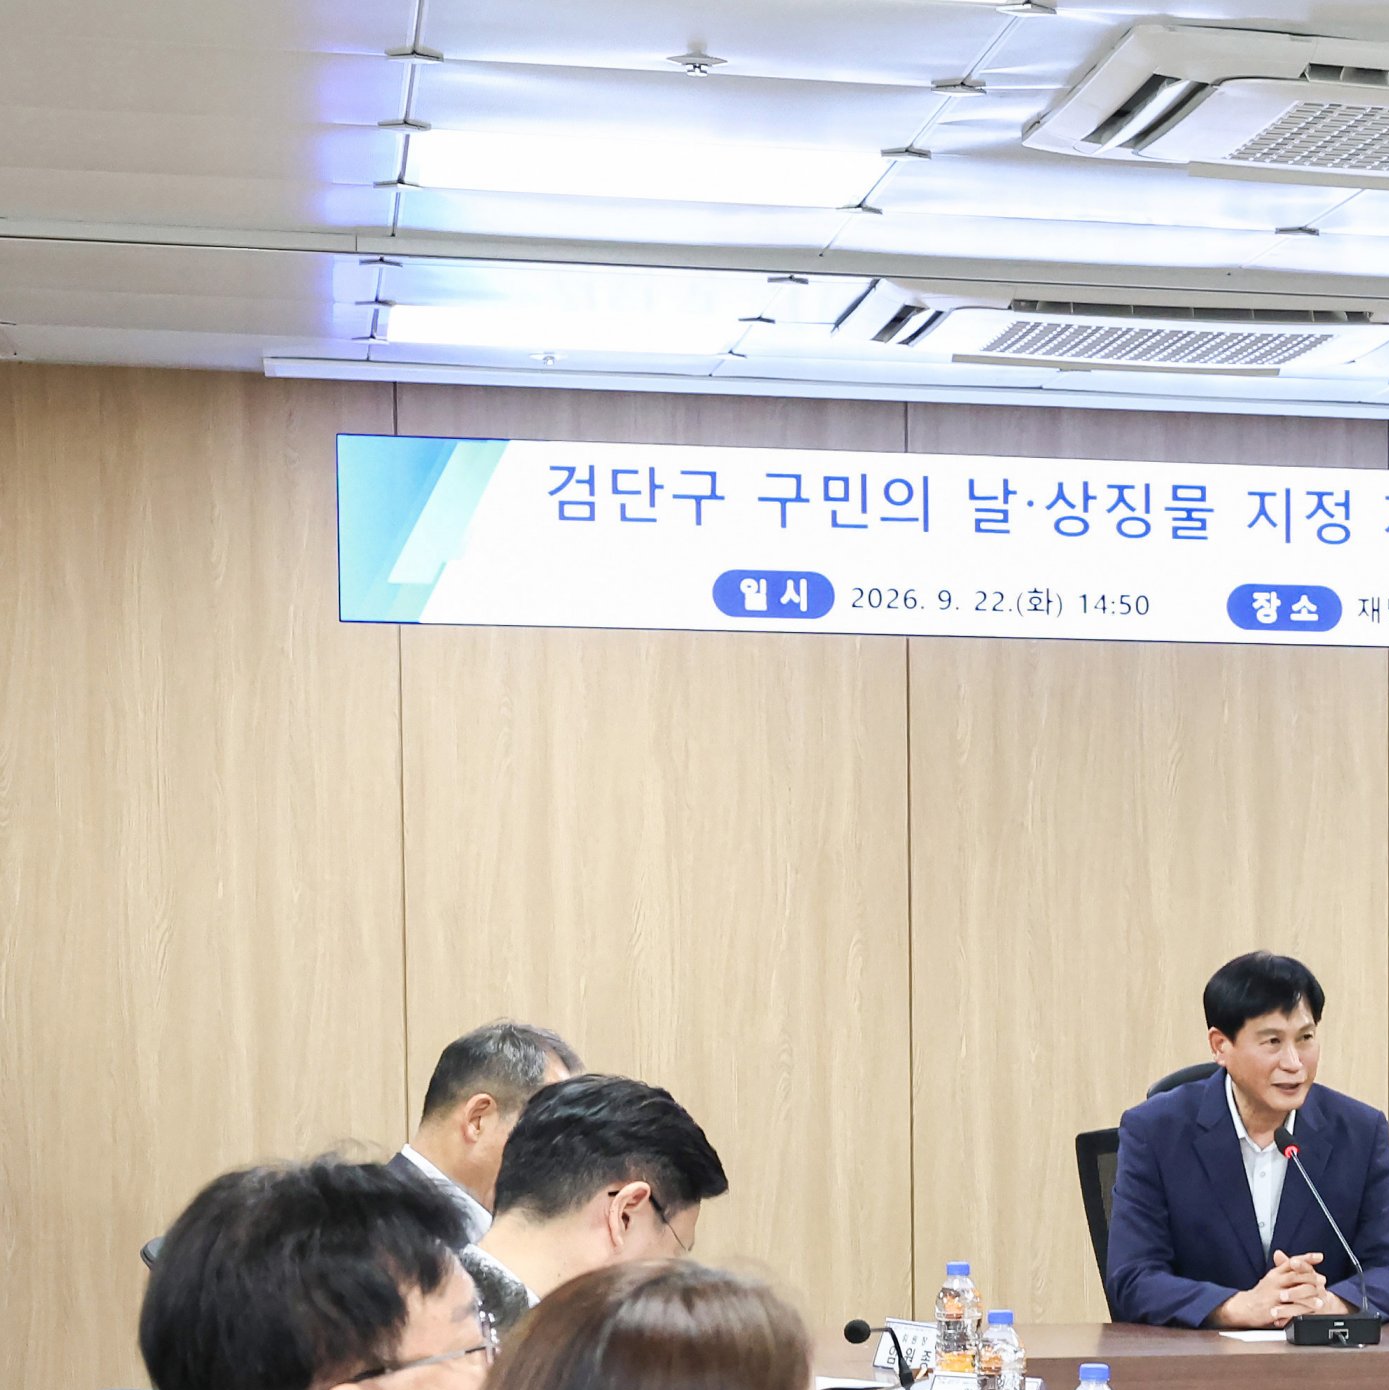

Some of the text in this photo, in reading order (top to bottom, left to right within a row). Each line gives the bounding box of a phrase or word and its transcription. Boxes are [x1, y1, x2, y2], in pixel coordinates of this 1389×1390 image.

[547, 464, 725, 526] 검단구
[757, 472, 929, 533] 구민의
[968, 477, 1215, 540] 날·상징물
[1246, 486, 1353, 546] 지정
[739, 577, 1150, 618] 일시 2026. 9. 22.(화) 14:50
[1251, 591, 1319, 625] 장소
